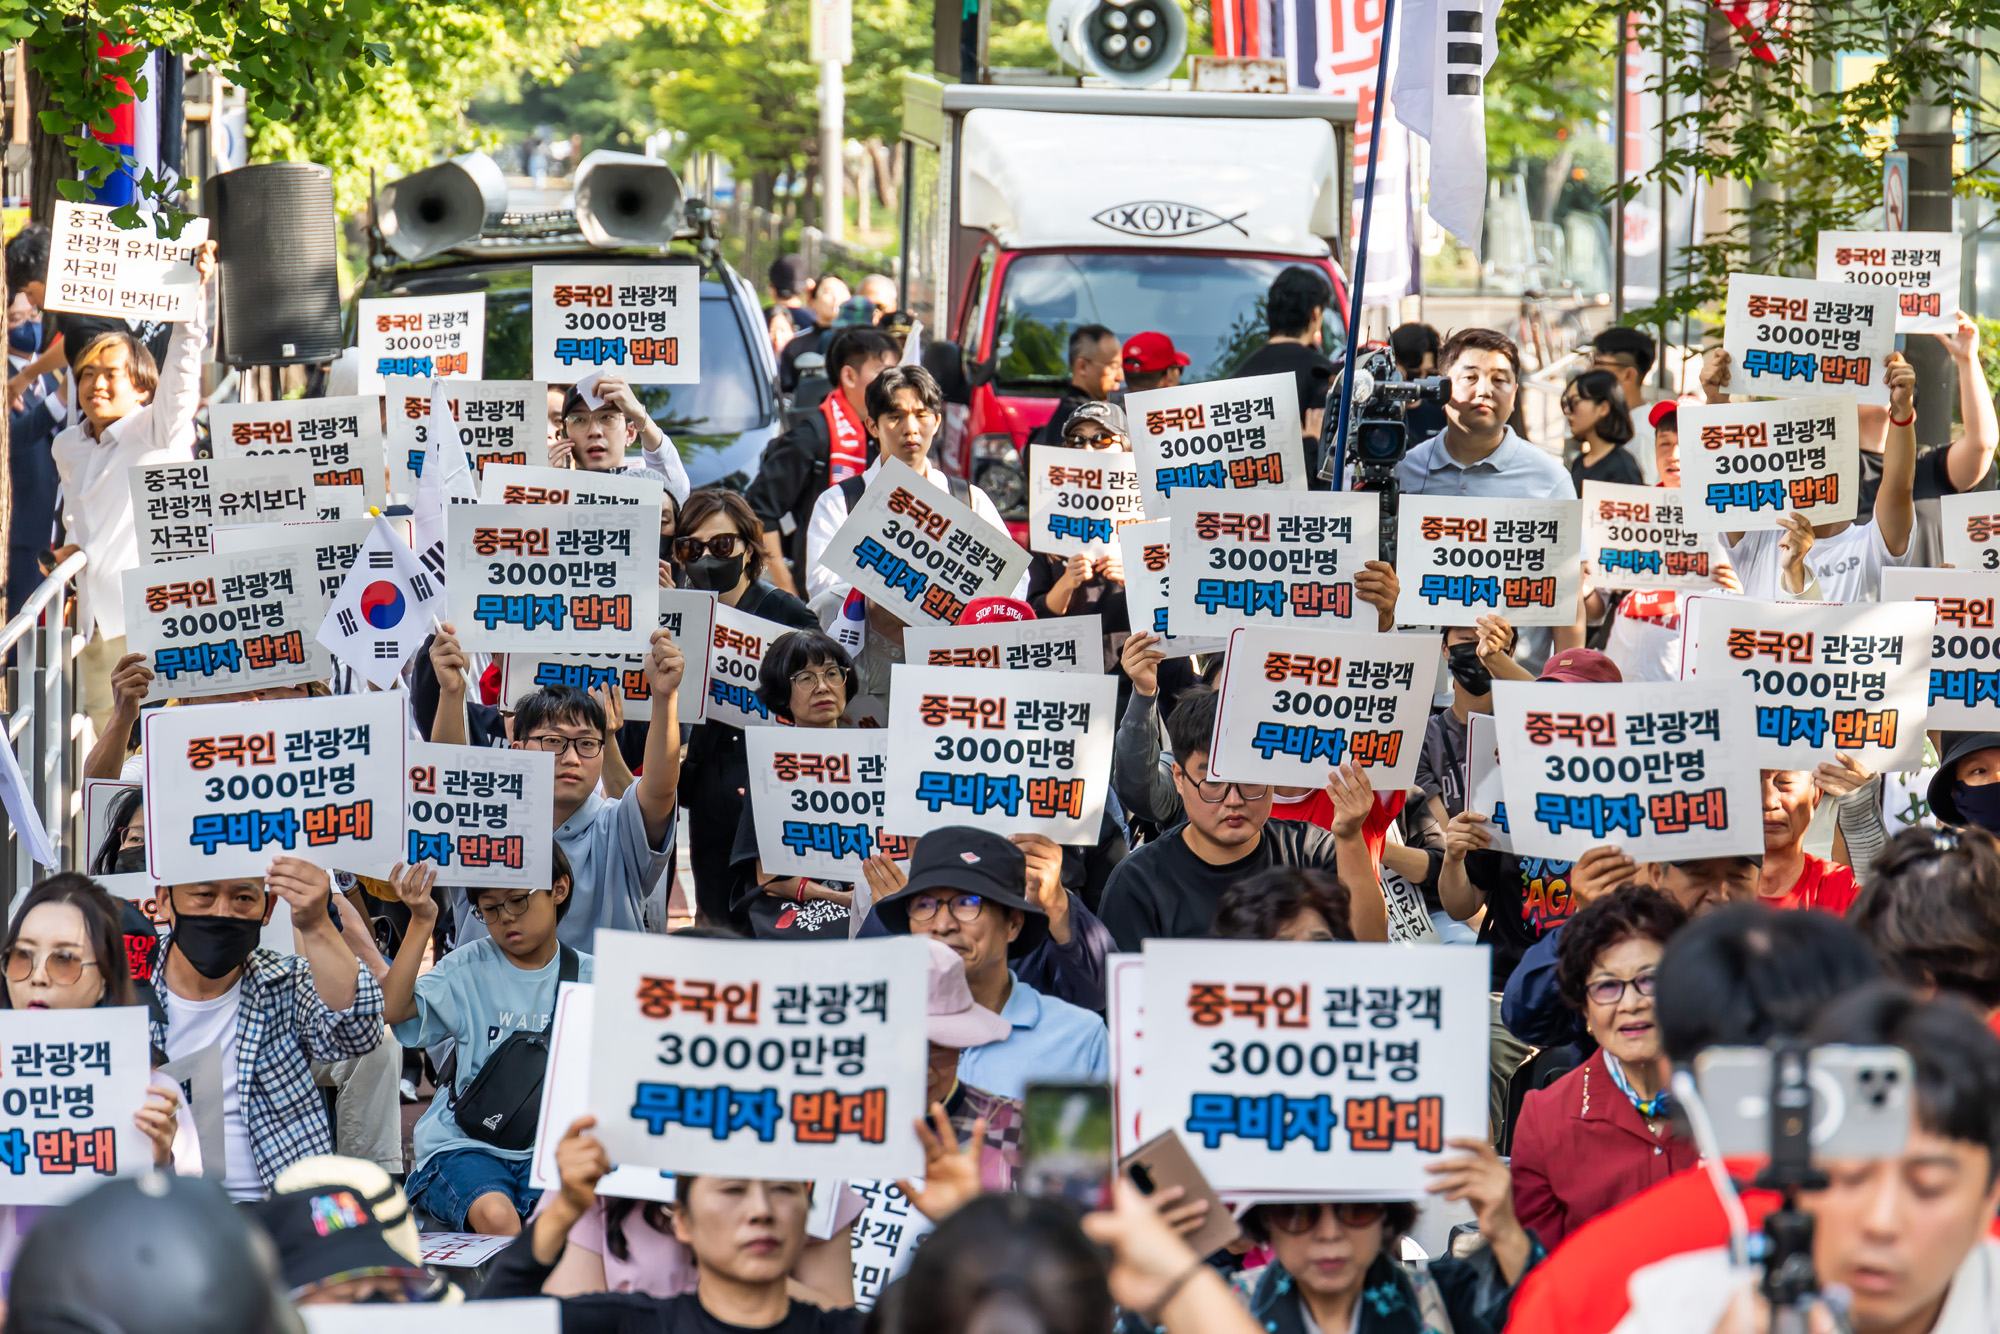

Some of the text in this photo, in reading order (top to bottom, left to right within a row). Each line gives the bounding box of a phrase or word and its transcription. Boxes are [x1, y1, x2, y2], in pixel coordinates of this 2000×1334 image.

[69, 210, 120, 233] 중국
[65, 233, 197, 266] 관광객 유치보다
[1835, 247, 1941, 267] 중국인 관광객
[63, 258, 117, 281] 자국민
[1844, 271, 1931, 288] 3000만명
[61, 283, 179, 312] 안전이 먼저다!
[553, 284, 677, 307] 중국인 관광객
[1747, 294, 1875, 327] 중국인 관광객
[1899, 293, 1941, 318] 반대
[375, 310, 469, 332] 중국인 관광객
[565, 311, 667, 333] 3000만명
[1756, 323, 1861, 352] 3000만명
[385, 332, 461, 351] 3000만명
[555, 337, 679, 366] 무비자 반대
[376, 352, 468, 377] 무비자 반대
[1743, 348, 1872, 387] 무비자 반대
[464, 400, 525, 422] 관광객
[1145, 396, 1275, 436] 중국인 관광객
[232, 415, 359, 446] 중국인 관광객
[415, 426, 514, 448] 30만명
[1160, 425, 1267, 460] 3000만명
[1701, 416, 1837, 451] 중국인 관광객
[1048, 465, 1140, 490] 중국인 관광
[1229, 452, 1285, 490] 반대
[1715, 445, 1827, 476] 3000만명
[144, 465, 210, 493] 중국인
[1705, 472, 1839, 514] 무비자 반대
[147, 493, 212, 520] 관광객
[218, 486, 307, 517] 유치보다
[1598, 499, 1683, 525] 중국인 관광
[150, 525, 212, 550] 자국민
[473, 527, 632, 557] 중국인 관광객
[886, 486, 1008, 582] 중국인 관광객
[1048, 513, 1113, 544] 무비자
[1195, 511, 1352, 544] 중국인 관광객
[1421, 516, 1559, 544] 중국인 관광객
[315, 543, 361, 572] 관광
[487, 561, 617, 588] 3000만명
[853, 535, 931, 603] 무비자
[881, 519, 985, 597] 3000만명
[1209, 547, 1338, 576] 3000만명
[1432, 547, 1546, 572] 3000만명
[1598, 547, 1711, 577] 무비자 반대
[145, 577, 217, 614] 중국인
[221, 568, 295, 602] 관광객
[1194, 577, 1289, 617] 무비자
[1290, 582, 1353, 619] 반대
[1419, 574, 1557, 608] 무비자 반대
[161, 601, 285, 639] 3000만명
[473, 594, 567, 631] 무비자
[569, 594, 633, 631] 반대
[975, 606, 992, 622] STOP
[992, 604, 1006, 615] THE
[154, 629, 305, 680] 무비자 반대
[713, 623, 762, 660] 중국인
[1005, 639, 1077, 669] 관광객
[1726, 627, 1904, 666] 중국인 관광객
[1932, 635, 2000, 660] 300
[622, 667, 652, 701] 반
[715, 655, 757, 682] 300
[1264, 651, 1415, 691] 중국인 관광객
[920, 693, 1092, 734] 중국인 관광객
[1271, 690, 1398, 724] 3000만명
[1251, 720, 1404, 768] 무비자 반대
[1525, 708, 1721, 748] 중국인 관광객
[1756, 705, 1899, 749] 비자 반대
[186, 723, 371, 771] 중국인 관광객
[933, 735, 1076, 770] 3000만명
[204, 762, 357, 803] 3000만명
[773, 751, 852, 785] 중국인
[1545, 748, 1706, 785] 3000만명
[442, 769, 524, 801] 관광객
[916, 770, 1086, 819] 무비자 반대
[189, 808, 300, 856] 무비자
[302, 798, 374, 848] 반대
[407, 799, 509, 830] 00만명
[1534, 791, 1646, 839] 무비자
[1647, 786, 1729, 835] 반대
[457, 833, 525, 870] 반대
[782, 820, 911, 862] 무비자 반
[122, 934, 157, 952] TOP
[126, 950, 149, 964] HE
[130, 963, 153, 980] EAL
[635, 974, 890, 1026] 중국인 관광객
[1186, 982, 1442, 1031] 중국인 관광객
[499, 1011, 550, 1030] WATE
[11, 1041, 112, 1078] 관광객
[656, 1032, 867, 1077] 3000만명
[1209, 1039, 1420, 1083] 3000만명
[3, 1084, 95, 1120] 0만명
[630, 1080, 889, 1145] 무비자 반대
[1185, 1092, 1444, 1153] 무비자 반대
[33, 1127, 118, 1177] 반대
[851, 1179, 911, 1217] 국인
[852, 1217, 904, 1257] 광객
